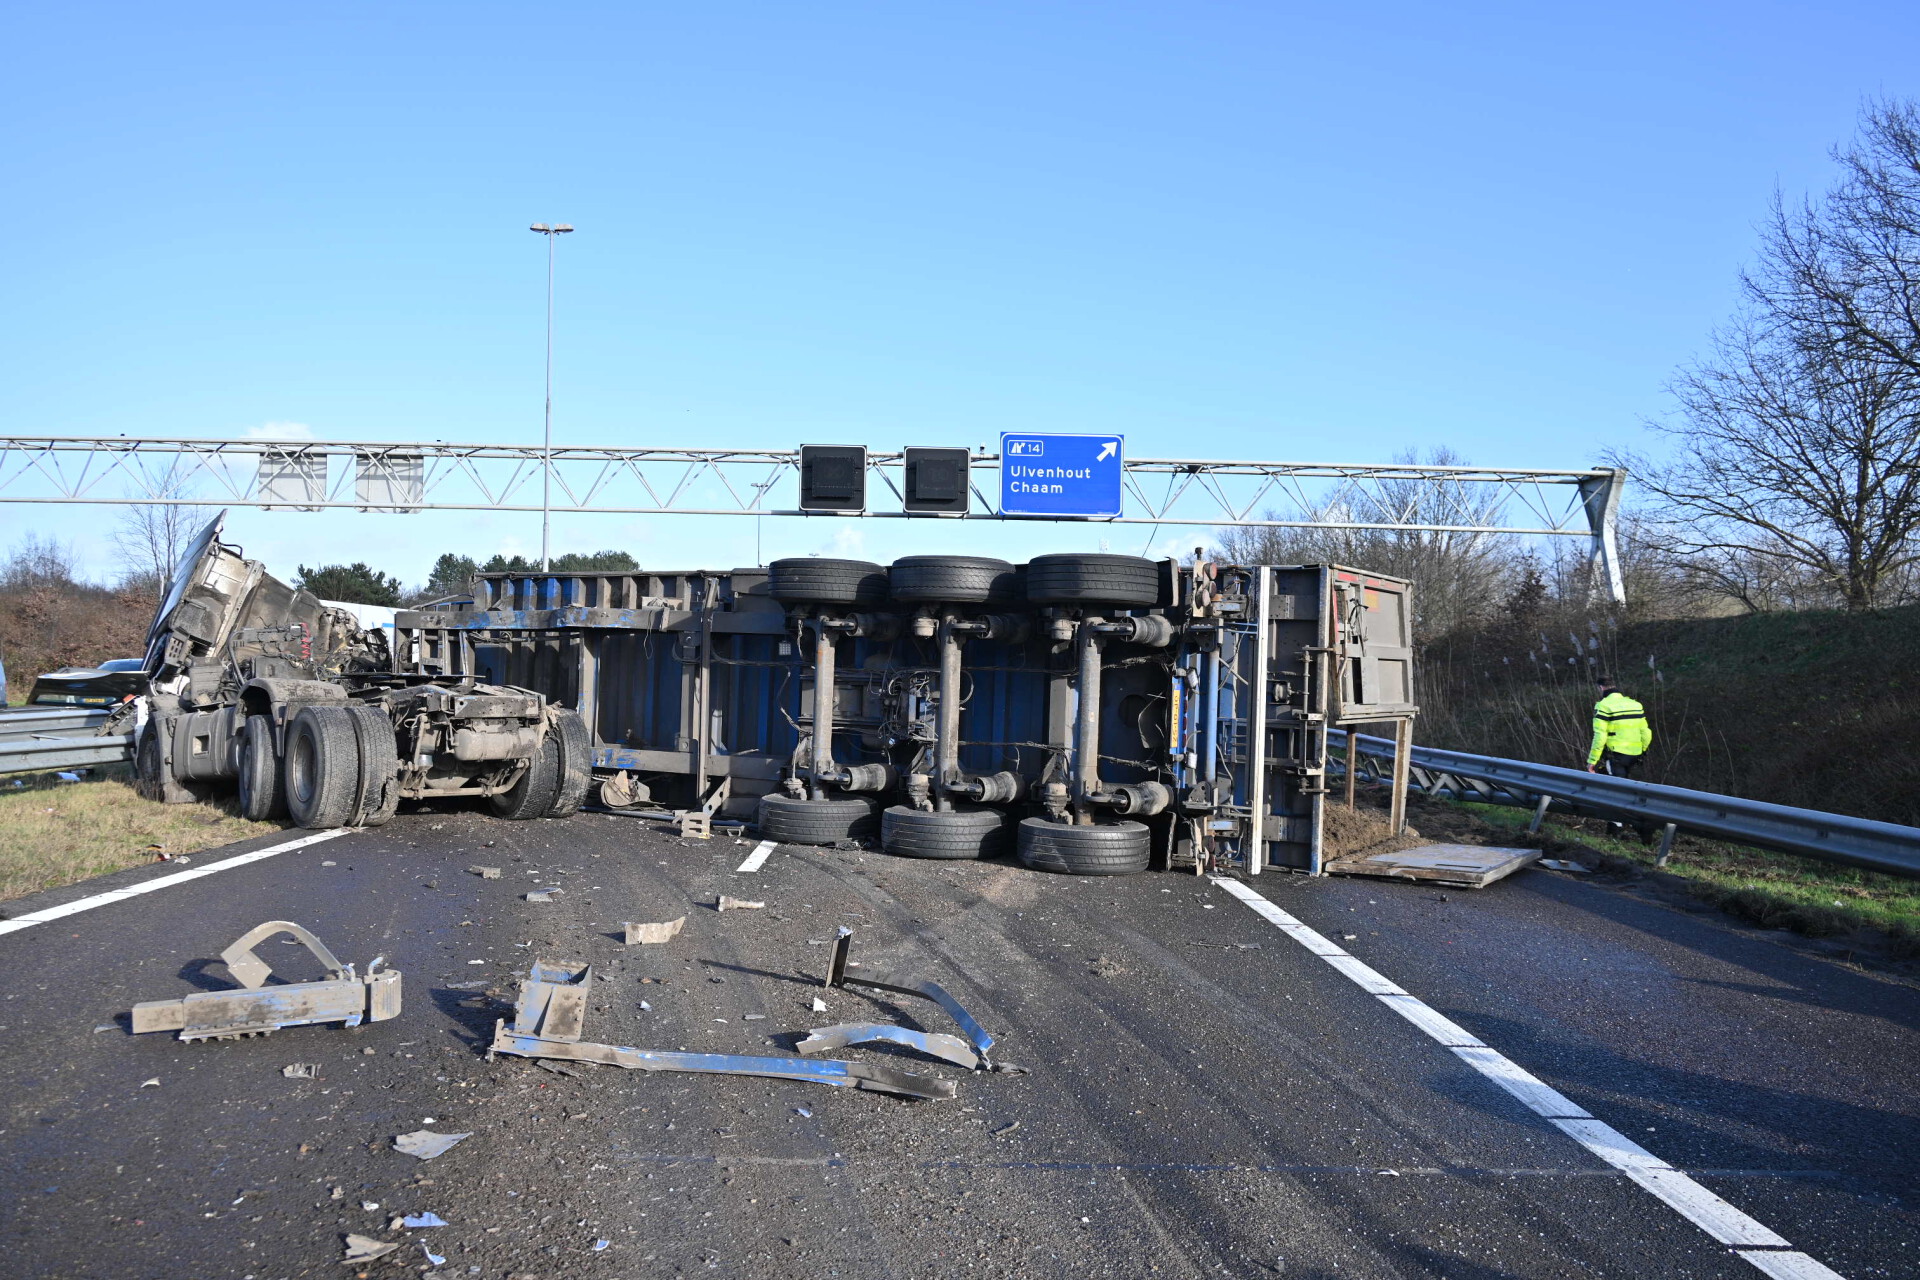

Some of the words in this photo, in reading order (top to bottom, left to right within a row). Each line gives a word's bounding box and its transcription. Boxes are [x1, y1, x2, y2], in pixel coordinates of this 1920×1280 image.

[1028, 444, 1040, 453] 14
[1010, 465, 1091, 479] Ulvenhout
[1010, 481, 1063, 494] Chaam
